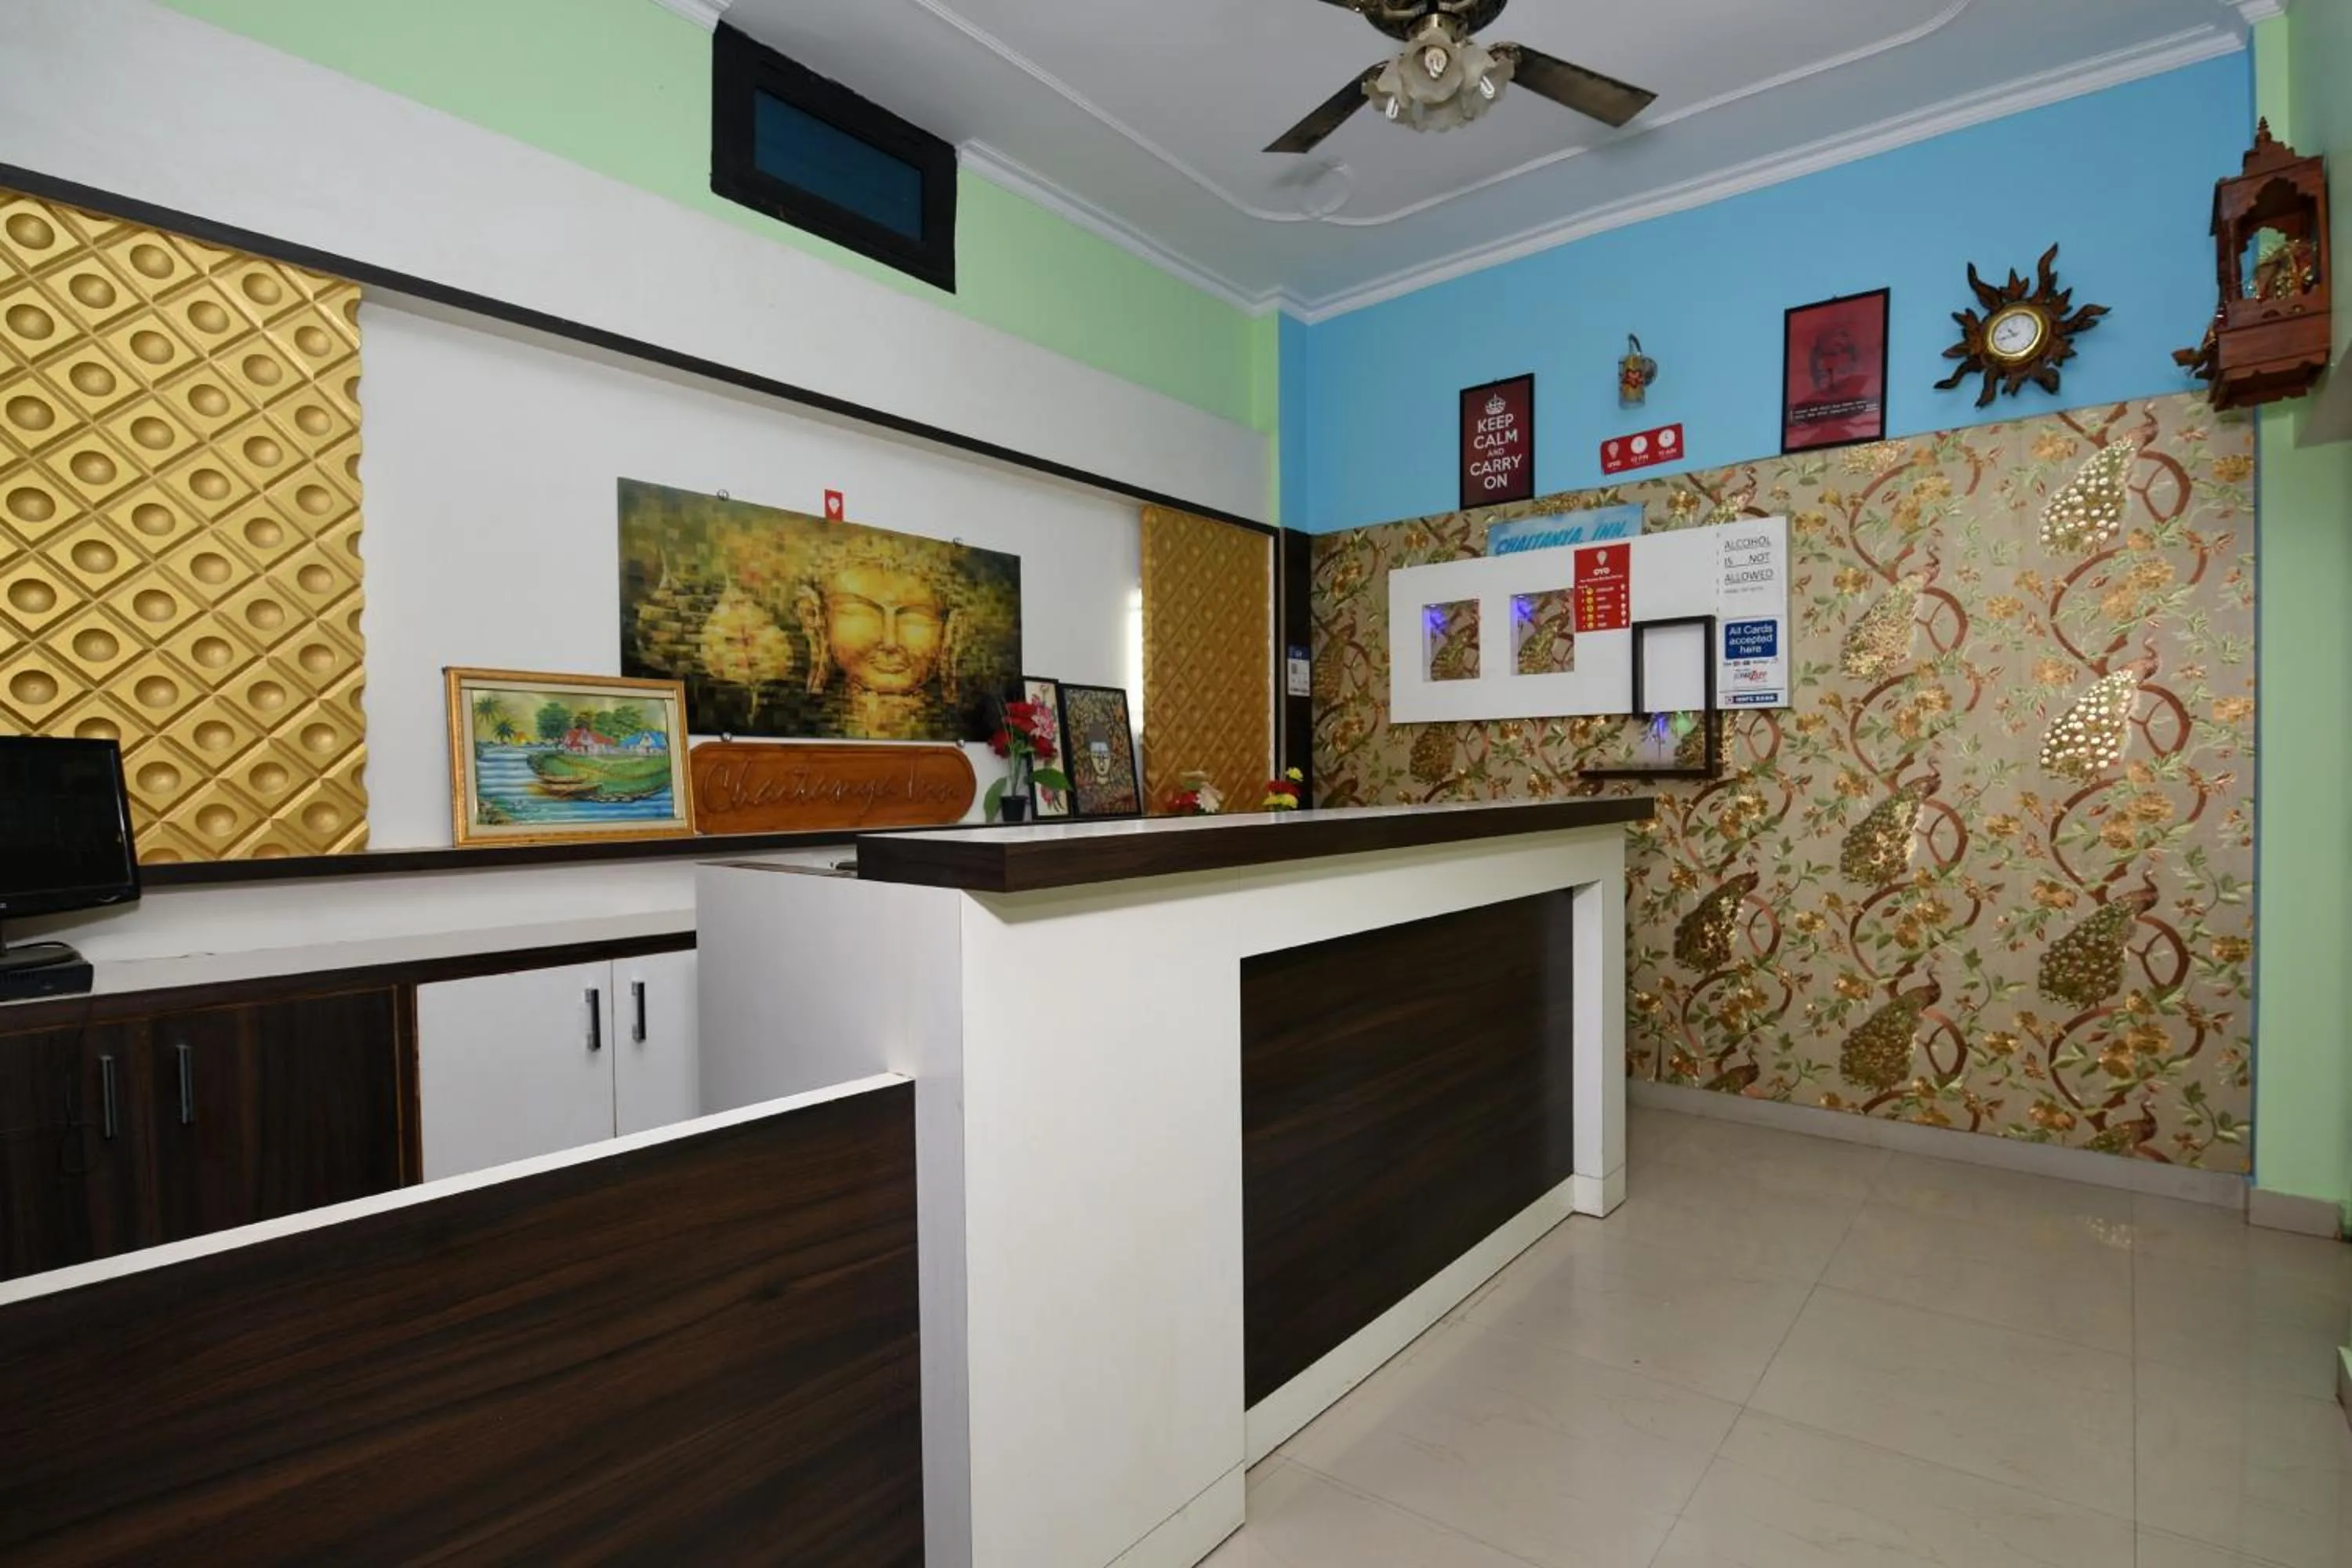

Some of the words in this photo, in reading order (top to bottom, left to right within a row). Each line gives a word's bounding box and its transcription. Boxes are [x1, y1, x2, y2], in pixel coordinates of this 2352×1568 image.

[1477, 413, 1514, 434] KEEP
[1473, 429, 1518, 449] CALM
[1486, 448, 1504, 457] AND
[1470, 454, 1523, 476] CARRY
[1484, 474, 1508, 490] ON
[1724, 535, 1772, 551] ALCOHOL
[1724, 556, 1733, 568] IS
[1748, 551, 1771, 565] NOT
[1593, 567, 1610, 576] OYO
[1724, 568, 1774, 585] ALLOWED
[1729, 626, 1741, 635] All
[1744, 624, 1773, 634] Cards
[1729, 633, 1773, 646] accepted
[1739, 644, 1762, 653] here
